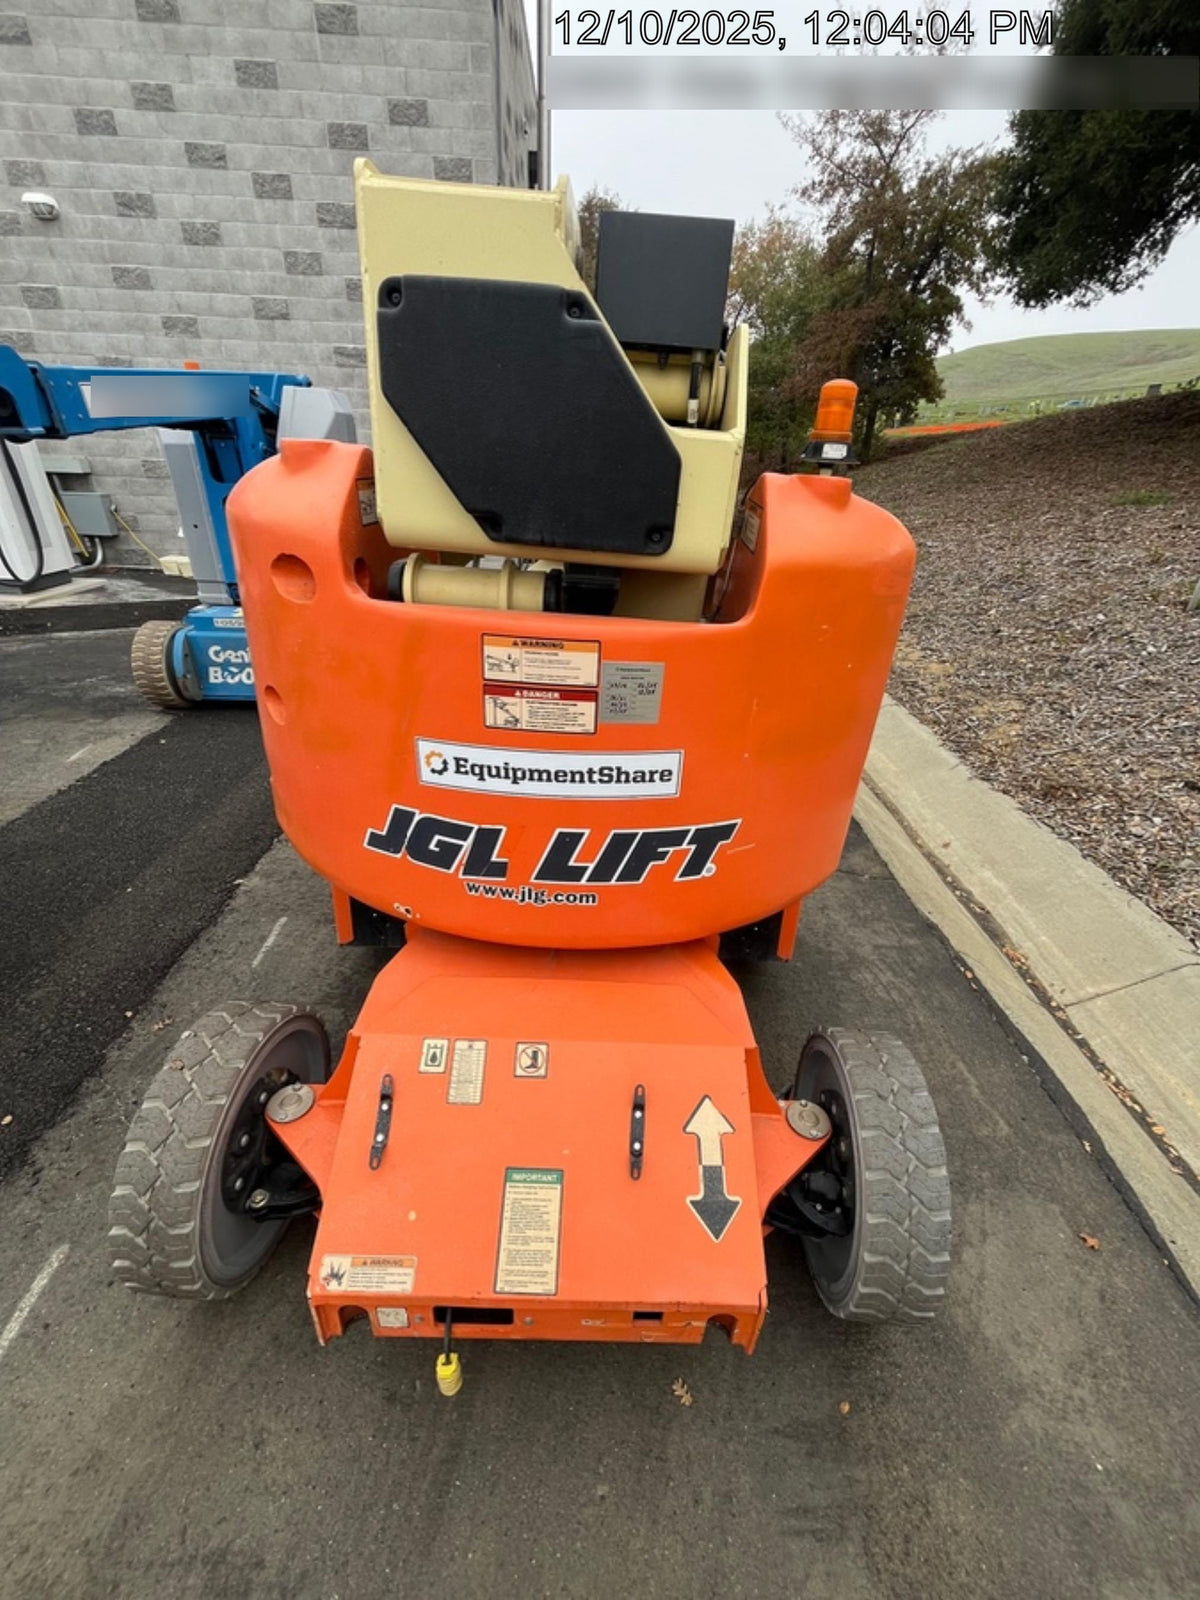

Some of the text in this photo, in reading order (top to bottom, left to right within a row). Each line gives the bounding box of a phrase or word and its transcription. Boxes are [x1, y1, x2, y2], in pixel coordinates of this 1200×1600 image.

[522, 690, 560, 699] DANGER
[453, 757, 673, 785] EquipmentShare
[364, 804, 508, 881] JGL
[466, 881, 598, 906] www.jlg.com
[511, 1172, 557, 1182] IMPORTANT
